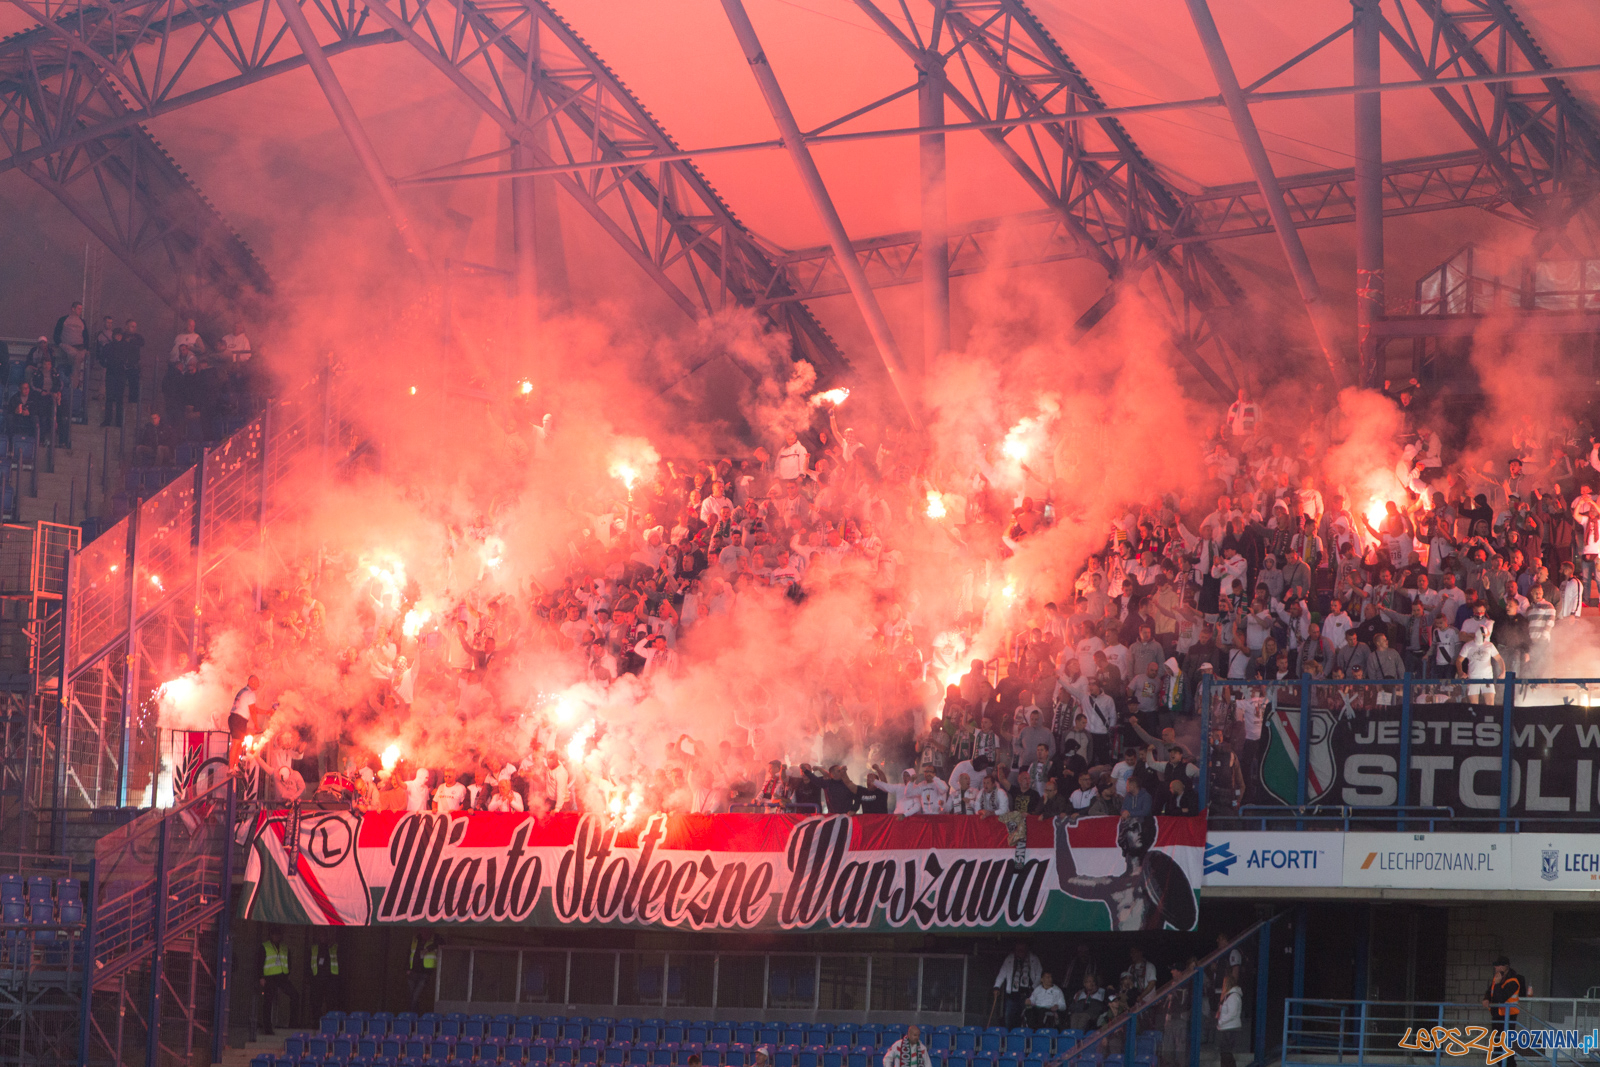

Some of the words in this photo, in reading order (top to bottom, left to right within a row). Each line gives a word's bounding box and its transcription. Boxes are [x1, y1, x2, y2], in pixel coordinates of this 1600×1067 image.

[1341, 753, 1600, 812] STOLI
[379, 812, 544, 921] Miasto
[778, 814, 1053, 929] Warszawa
[1380, 852, 1494, 871] LECHPOZNAN.PL
[1565, 853, 1600, 872] LECH
